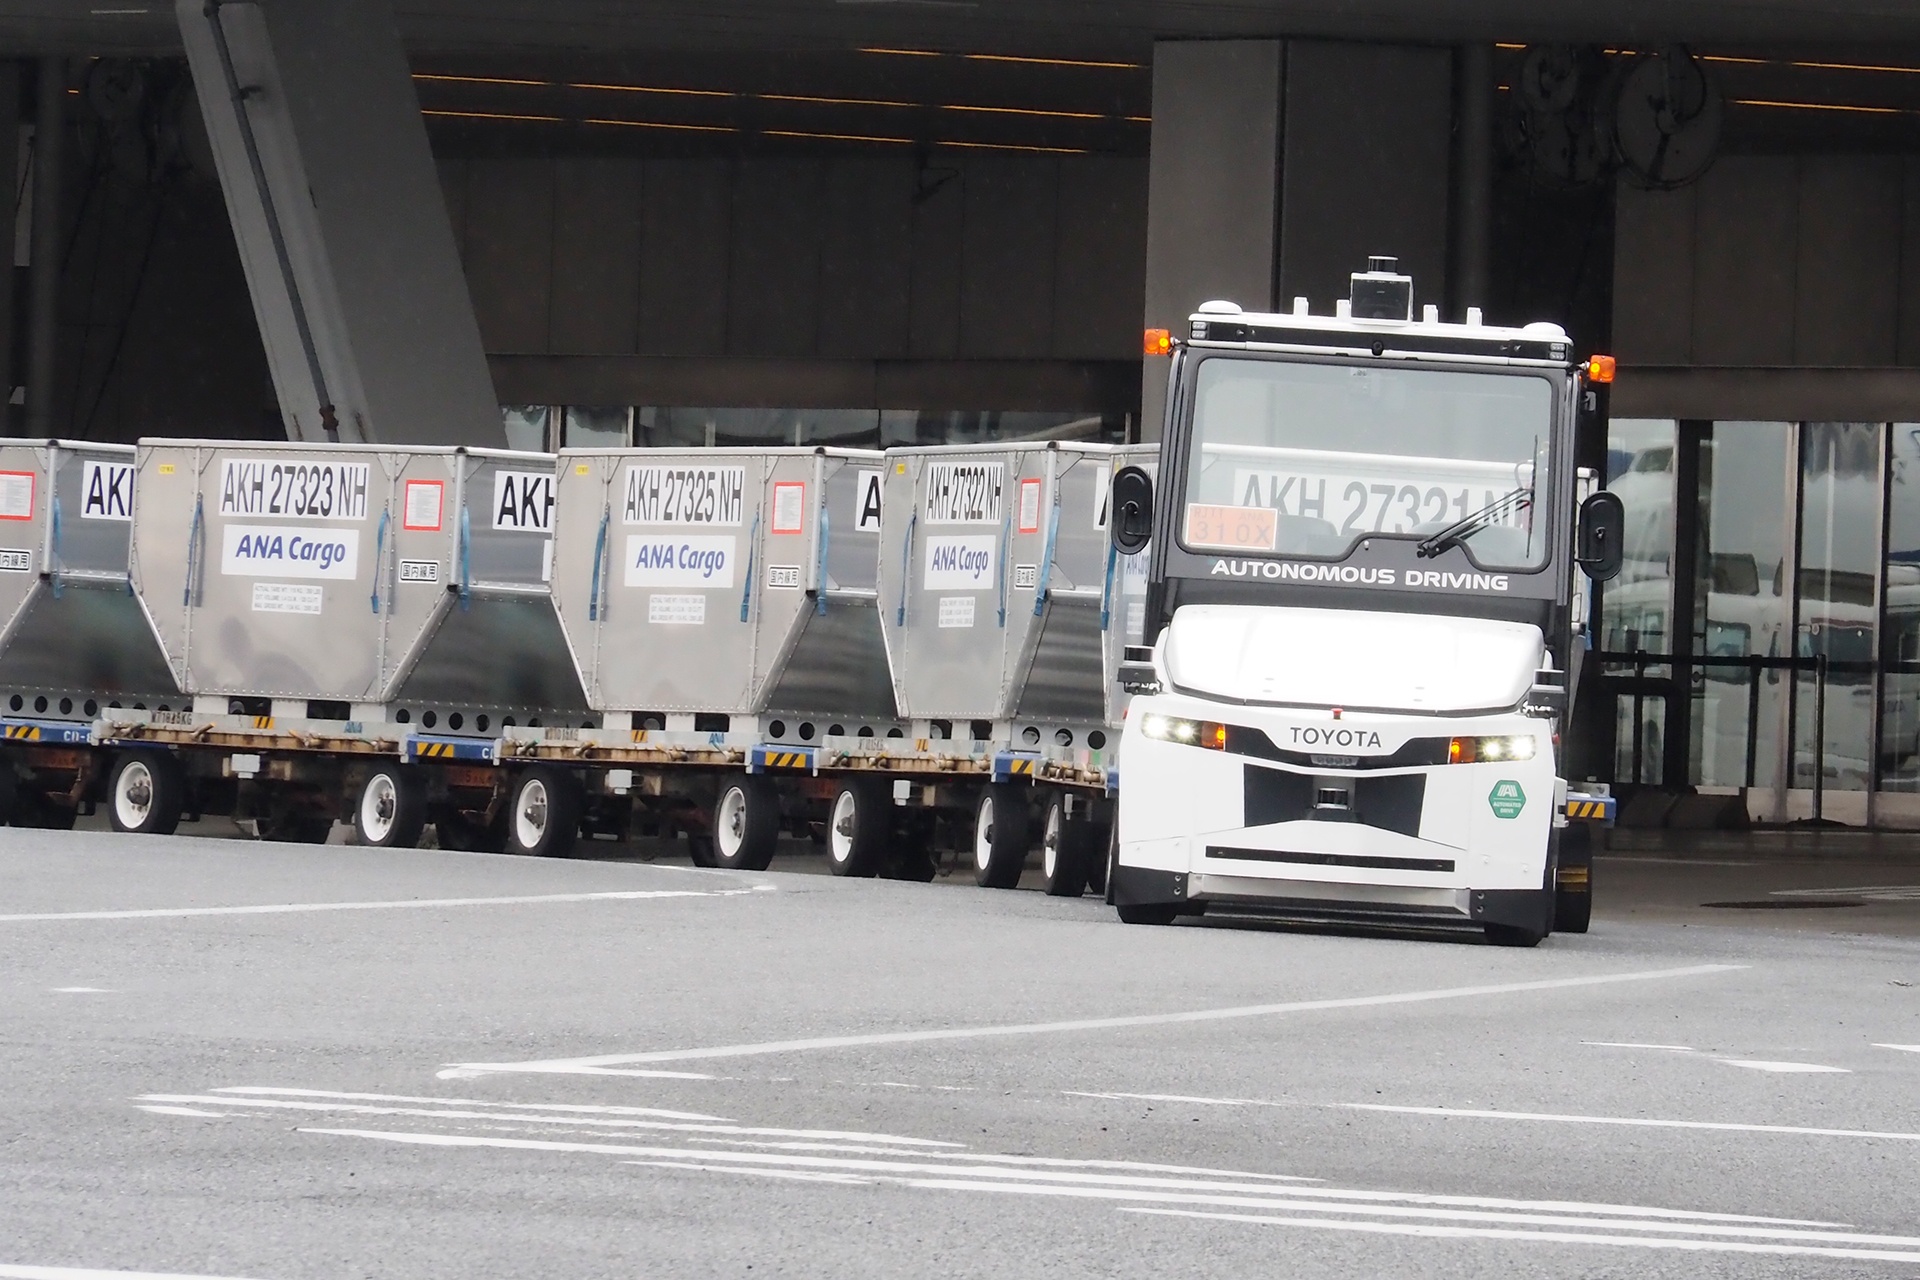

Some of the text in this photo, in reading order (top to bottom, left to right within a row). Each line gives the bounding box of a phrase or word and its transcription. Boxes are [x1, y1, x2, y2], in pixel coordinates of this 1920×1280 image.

[222, 463, 265, 513] AKH
[269, 464, 333, 516] 27323
[338, 466, 367, 517] NH
[625, 469, 661, 521] AKH
[663, 470, 716, 522] 27325
[719, 470, 743, 522] NH
[926, 466, 950, 520] AKH
[951, 466, 985, 521] 27322
[985, 466, 1003, 520] NH
[1242, 474, 1326, 520] AKH
[1341, 481, 1469, 537] 27321
[235, 534, 346, 570] ANA Cargo
[636, 544, 725, 578] ANA Cargo
[931, 545, 989, 580] ANA Cargo
[1211, 559, 1509, 591] AUTONOMOUS DRIVING
[1290, 727, 1382, 748] TOYOTA
